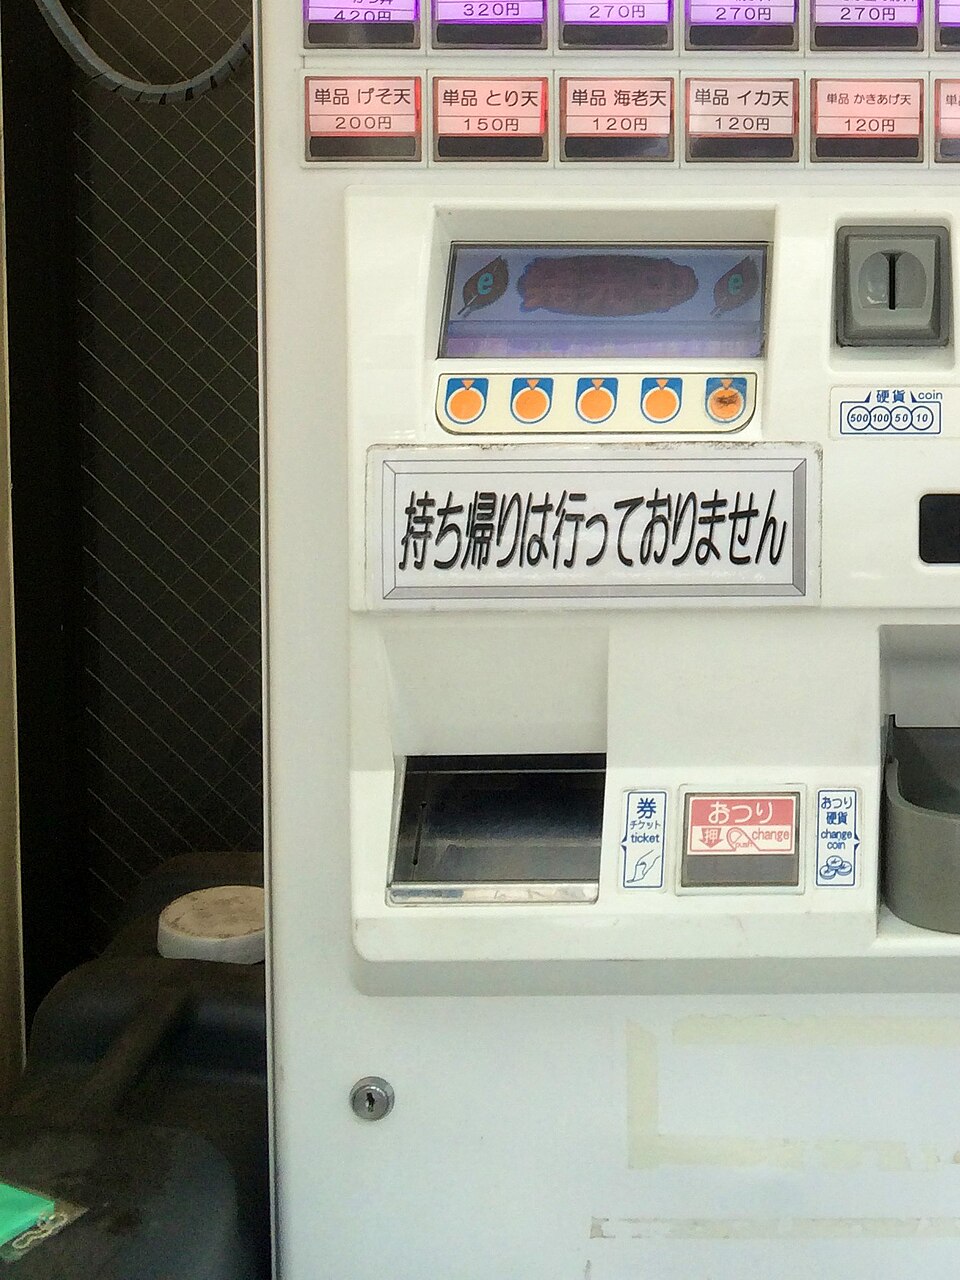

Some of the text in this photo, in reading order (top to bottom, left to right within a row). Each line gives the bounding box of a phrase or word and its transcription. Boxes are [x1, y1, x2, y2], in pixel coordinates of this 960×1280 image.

[463, 3, 519, 16] 320円
[716, 8, 771, 20] 270円
[841, 8, 895, 20] 270円
[314, 89, 410, 105] 単品 げそ天
[487, 90, 538, 107] とり天
[614, 90, 666, 106] 海老天
[694, 89, 789, 107] 単品 イカ天
[854, 93, 911, 106] かきあげ天
[336, 117, 391, 129] 200円
[464, 118, 519, 131] 150円
[715, 118, 769, 130] 120円
[876, 390, 943, 403] 硬貨 coin
[851, 414, 928, 422] 500 100 50 10
[399, 488, 788, 570] 持ち帰りは行っておりません
[637, 798, 656, 819] 券
[821, 797, 853, 809] おつり
[708, 802, 773, 824] おつり
[827, 812, 847, 824] 硬貨
[630, 821, 660, 830] チケット
[631, 833, 659, 843] ticket
[752, 829, 789, 841] change
[821, 830, 852, 840] change
[827, 840, 845, 849] coin
